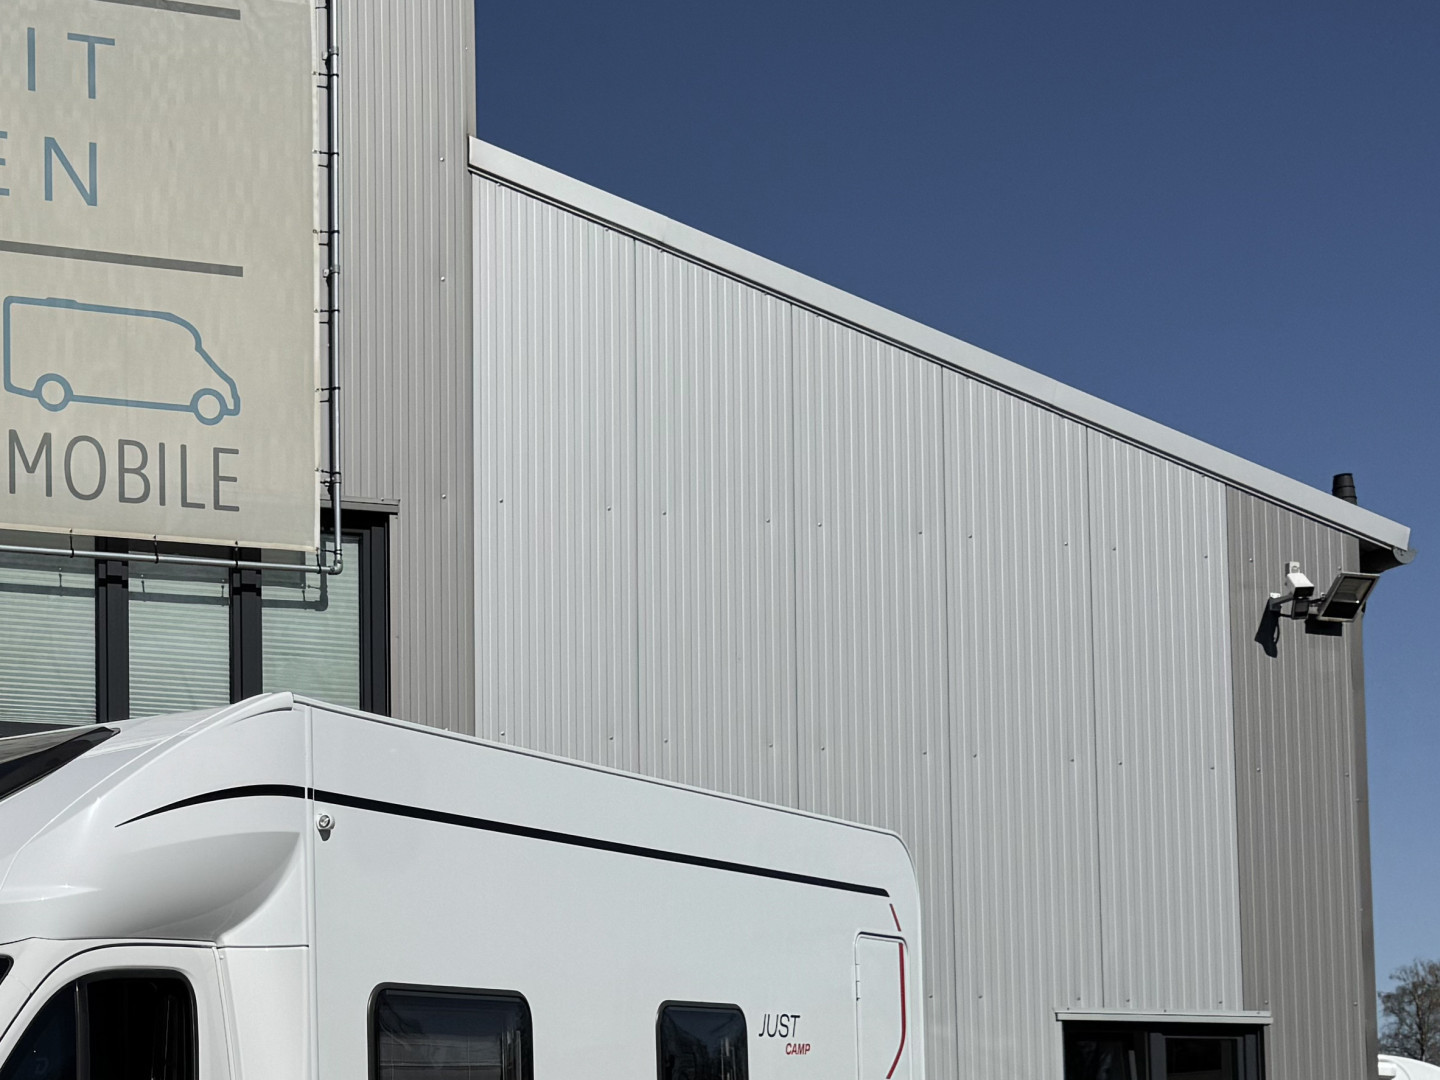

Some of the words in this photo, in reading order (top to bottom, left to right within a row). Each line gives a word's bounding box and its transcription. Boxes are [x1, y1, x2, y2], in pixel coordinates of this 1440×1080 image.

[8, 430, 240, 513] MOBILE
[758, 1013, 801, 1038] JUST
[785, 1042, 811, 1056] CAMP
